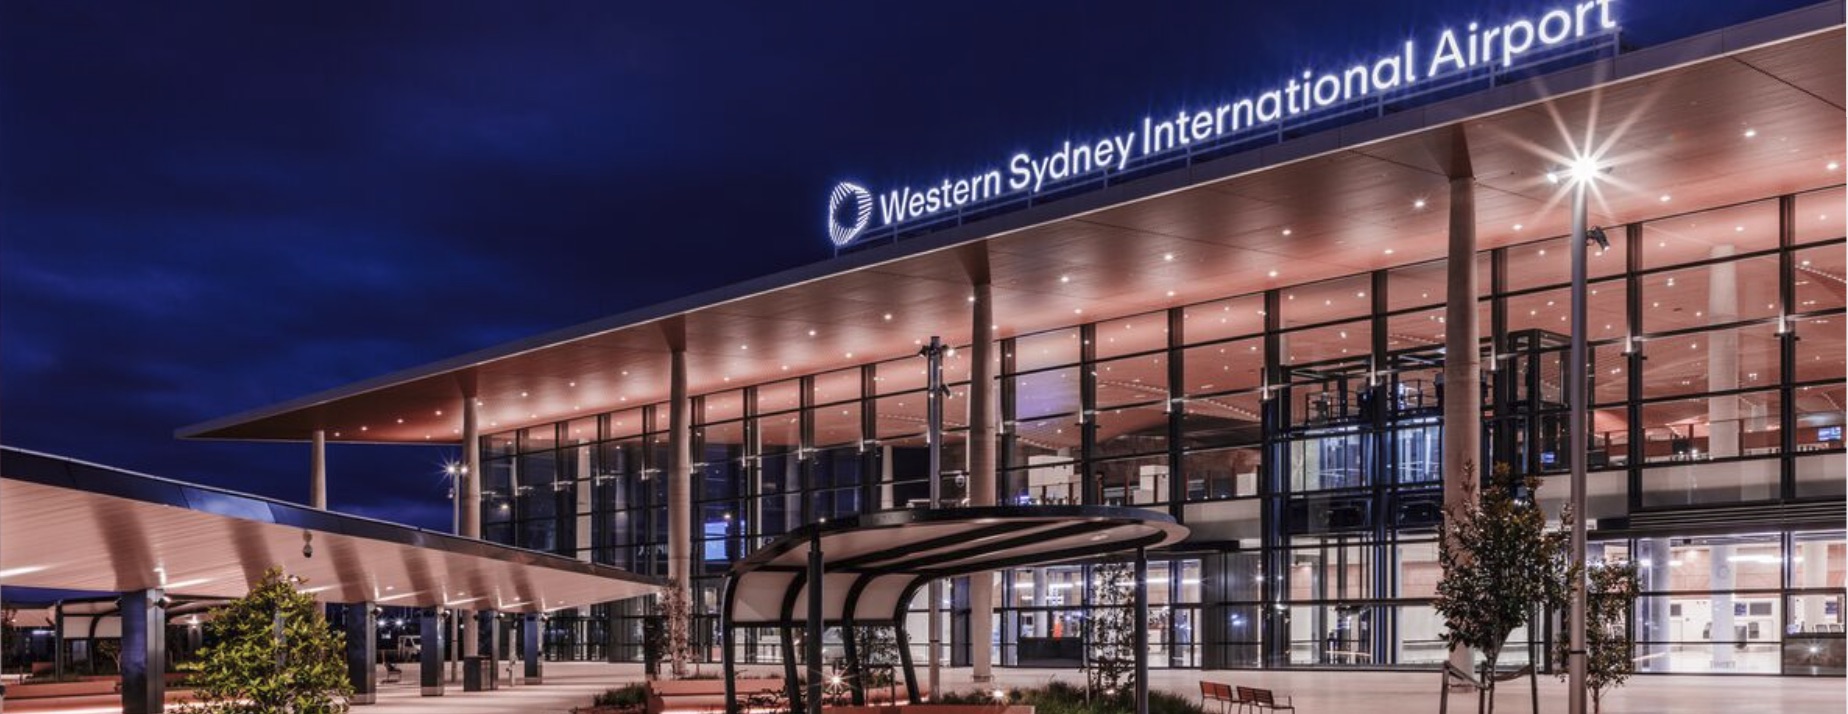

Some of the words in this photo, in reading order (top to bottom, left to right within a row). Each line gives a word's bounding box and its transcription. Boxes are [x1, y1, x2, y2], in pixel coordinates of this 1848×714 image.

[880, 170, 1000, 225] Western
[1009, 132, 1135, 193] Sydney
[1143, 41, 1415, 155] International
[1428, 0, 1616, 77] Airport
